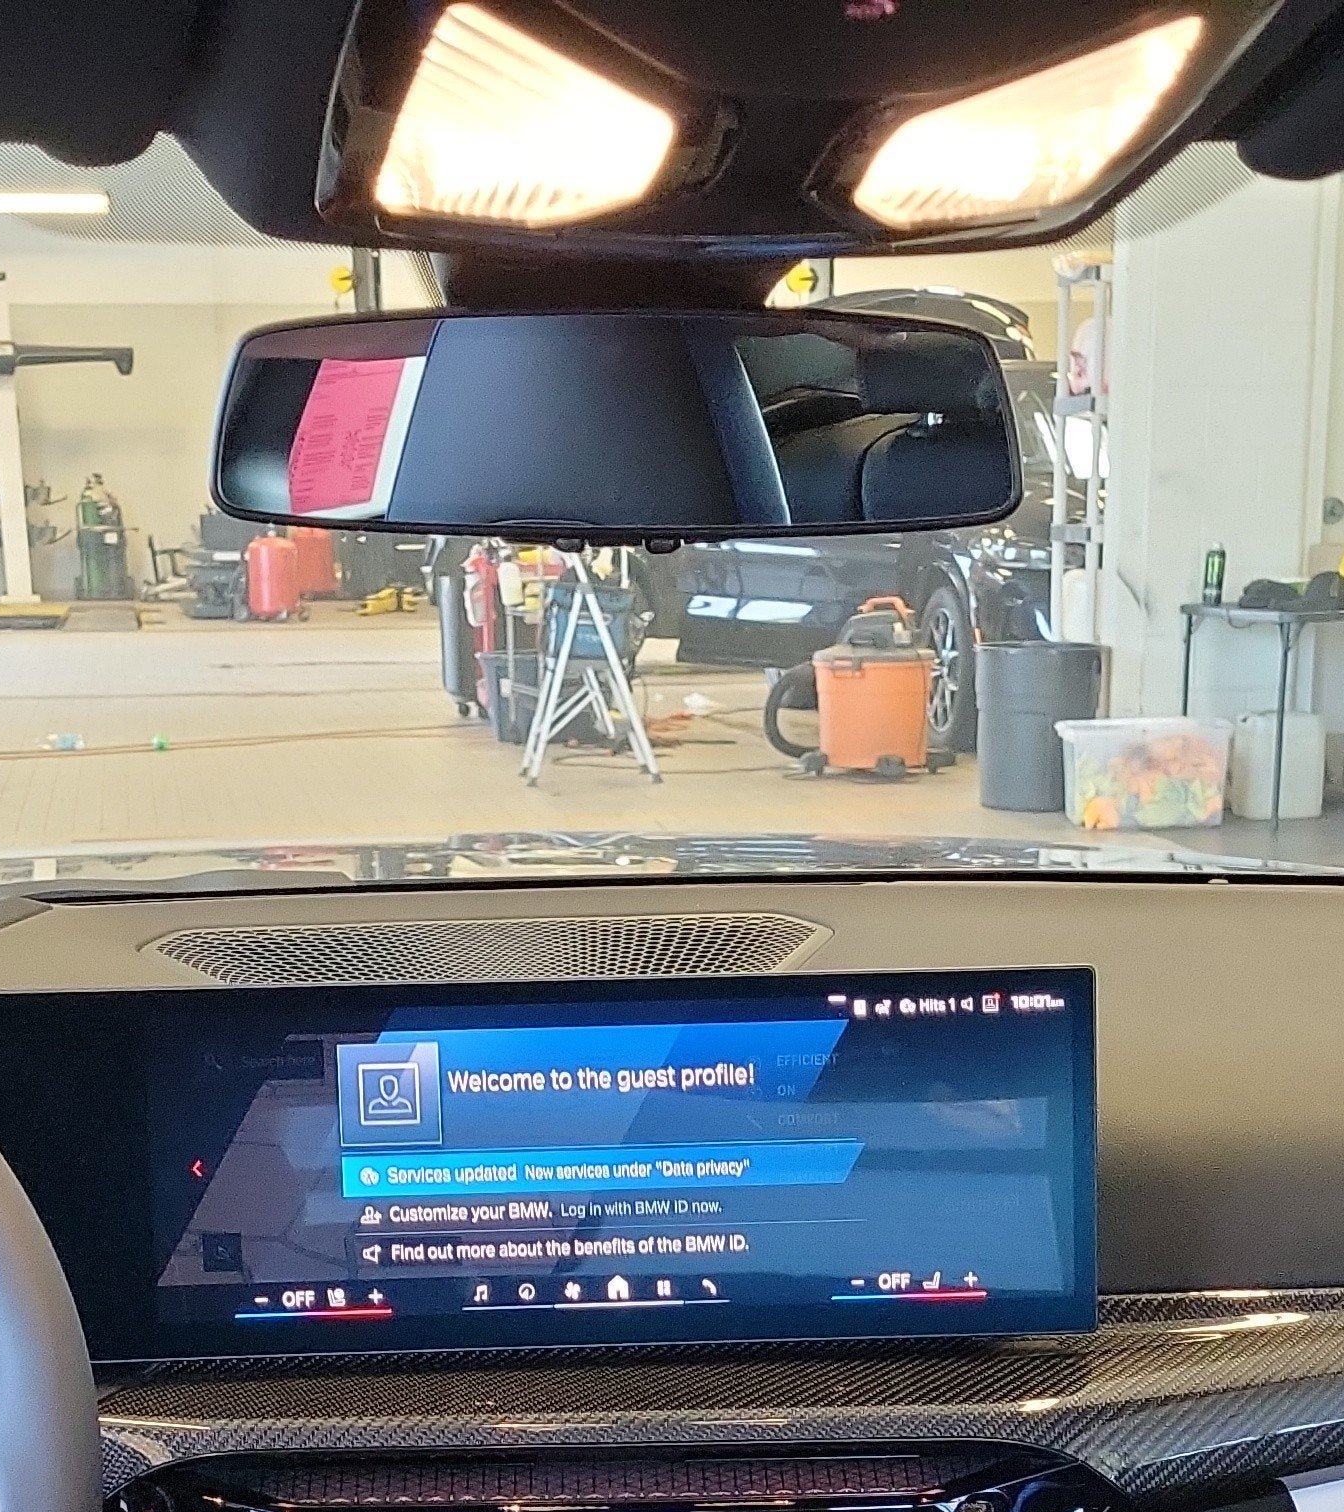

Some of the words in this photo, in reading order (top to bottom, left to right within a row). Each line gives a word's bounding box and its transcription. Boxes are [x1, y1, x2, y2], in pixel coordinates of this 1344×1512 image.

[919, 998, 946, 1012] Hits
[447, 1068, 545, 1093] Welcome
[549, 1069, 570, 1090] to
[577, 1066, 612, 1090] the
[617, 1067, 676, 1094] guest
[681, 1063, 756, 1092] profile!
[387, 1165, 452, 1184] Services
[454, 1163, 518, 1185] updated
[525, 1163, 554, 1181] New
[556, 1162, 611, 1180] services
[613, 1160, 653, 1178] under
[656, 1160, 694, 1177] "Data
[696, 1158, 751, 1179] privacy"
[389, 1203, 469, 1223] Customize
[471, 1205, 506, 1224] your
[508, 1201, 553, 1220] BMW.
[560, 1202, 586, 1219] Log
[589, 1201, 602, 1217] in
[604, 1200, 632, 1216] with
[634, 1200, 670, 1215] BMW
[674, 1199, 689, 1214] ID
[692, 1201, 724, 1214] now.
[391, 1242, 425, 1261] Find
[427, 1242, 454, 1260] out
[456, 1244, 496, 1260] more
[499, 1240, 543, 1258] about
[545, 1239, 572, 1257] the
[574, 1237, 636, 1257] benefits
[638, 1236, 655, 1254] of
[657, 1236, 682, 1253] the
[685, 1234, 726, 1252] BMW
[729, 1233, 750, 1251] ID.
[878, 1272, 910, 1290] OFF
[282, 1290, 315, 1307] OFF
